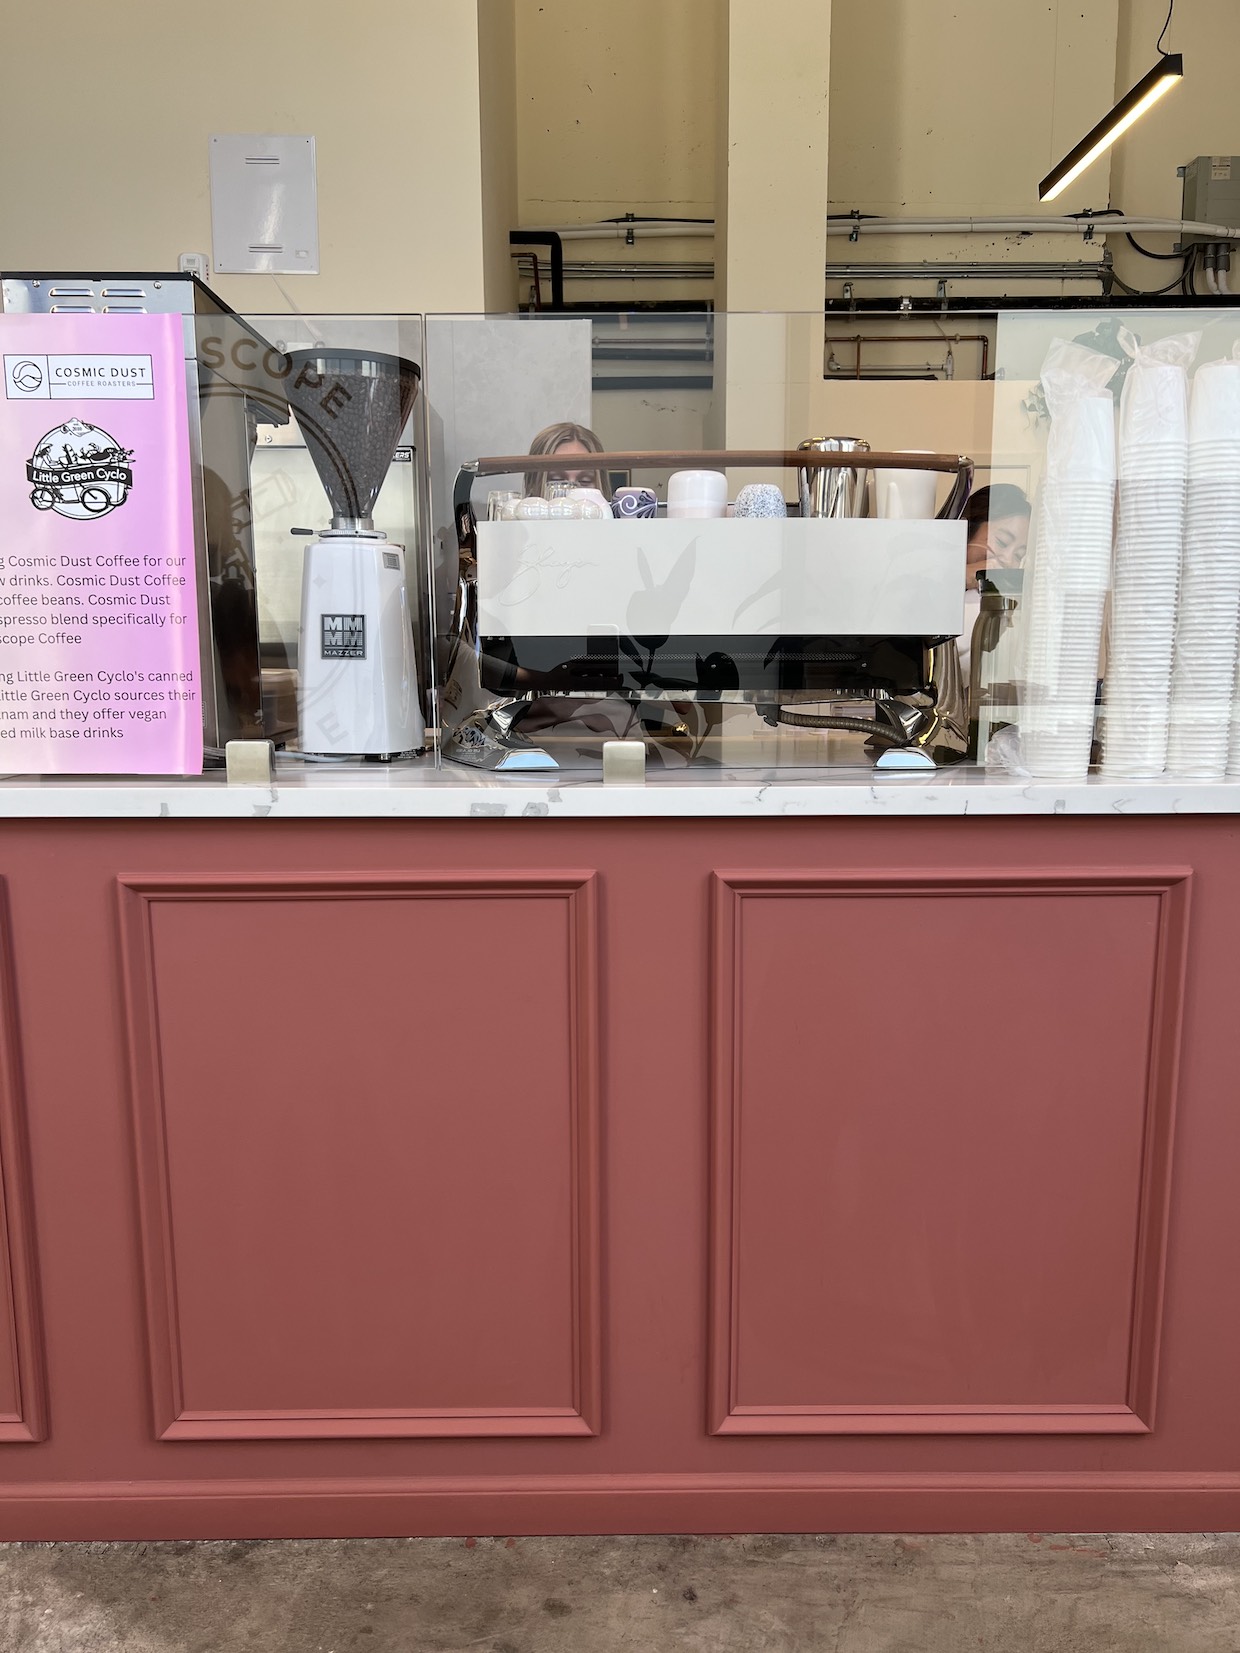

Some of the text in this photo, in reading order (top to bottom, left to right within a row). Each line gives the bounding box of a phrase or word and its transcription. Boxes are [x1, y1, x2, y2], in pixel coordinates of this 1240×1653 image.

[55, 367, 146, 378] COSMIC DUST
[32, 468, 127, 483] Little Green Cyclo
[8, 555, 57, 567] Cosmic
[60, 555, 92, 567] Dust
[95, 555, 140, 567] Coffee
[143, 555, 162, 567] for
[165, 557, 186, 567] our
[9, 574, 53, 586] drinks.
[56, 574, 106, 586] Cosmic
[109, 575, 140, 586] Dust
[144, 574, 186, 586] Coffee
[41, 594, 84, 606] beans.
[88, 594, 137, 606] Cosmic
[140, 594, 171, 606] Dust
[51, 613, 88, 625] blend
[92, 613, 166, 627] specifically
[169, 614, 187, 625] for
[38, 633, 82, 644] Coffee
[17, 671, 50, 682] Little
[54, 671, 94, 682] Green
[97, 671, 145, 685] Cyclo's
[148, 671, 193, 682] canned
[0, 689, 196, 703] ittle Green Cyclo sources their
[0, 708, 167, 722] nam and they offer vegan
[20, 727, 46, 738] milk
[50, 727, 80, 738] base
[84, 727, 124, 738] drinks
